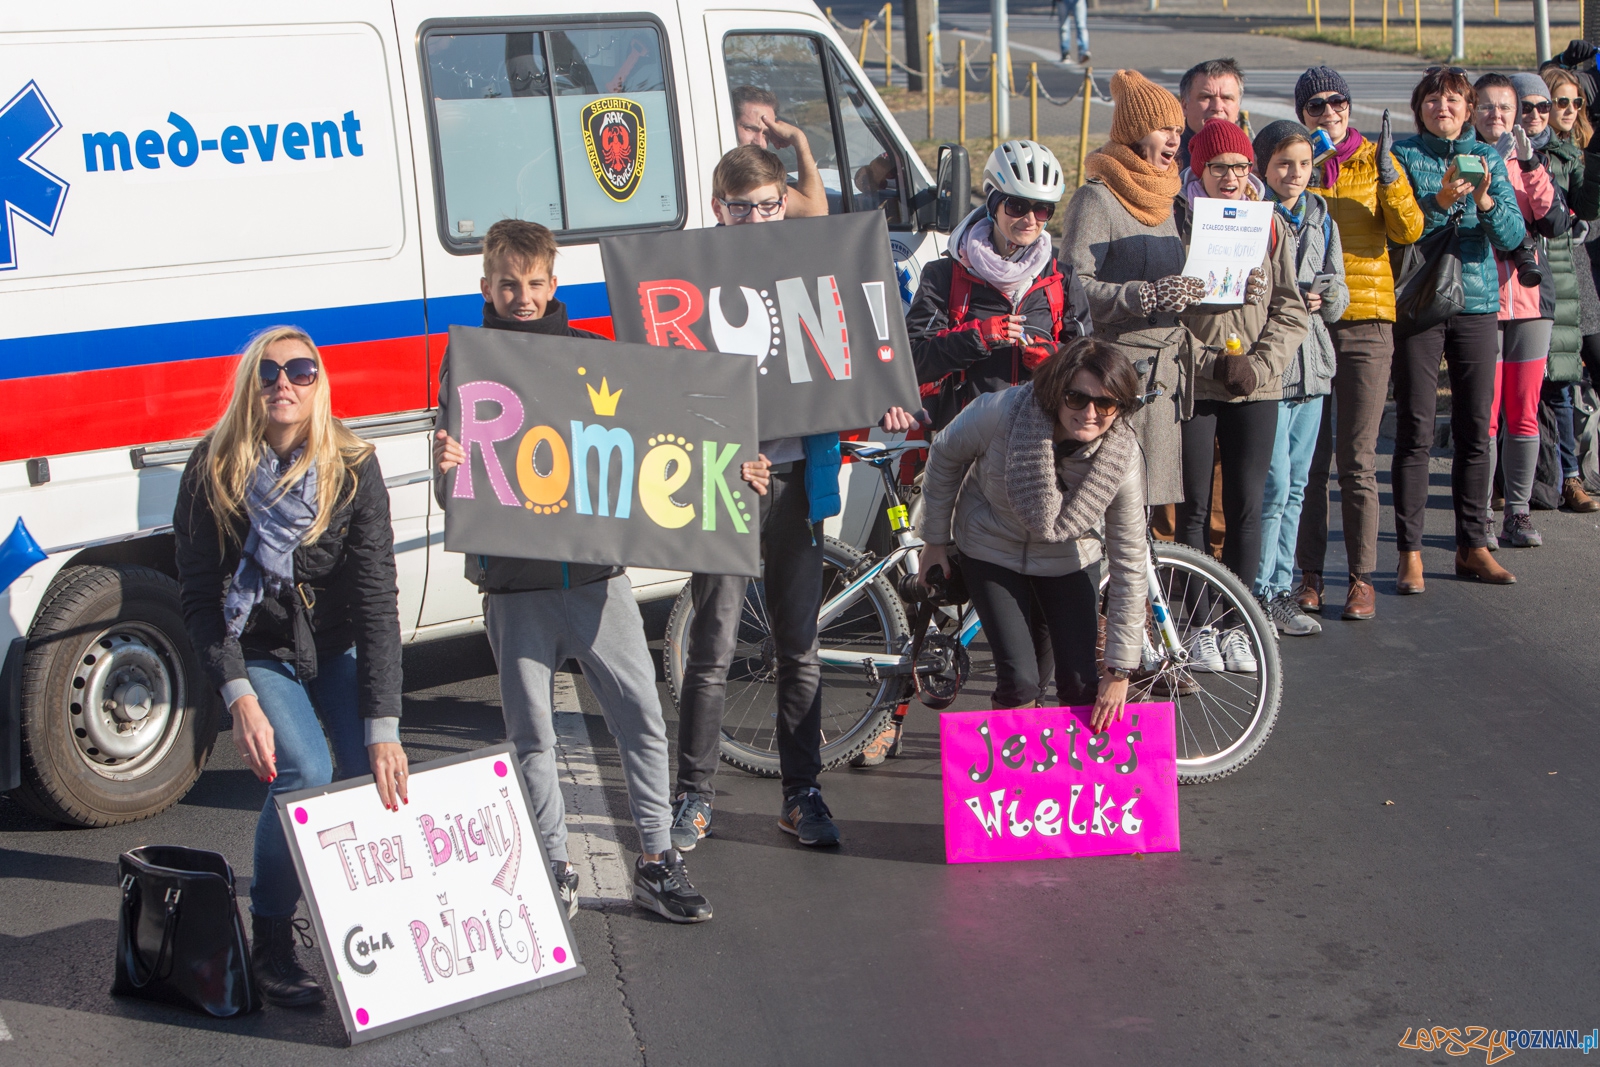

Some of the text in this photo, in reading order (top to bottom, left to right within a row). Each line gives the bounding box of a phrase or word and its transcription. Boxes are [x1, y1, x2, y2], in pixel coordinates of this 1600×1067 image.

[591, 99, 632, 114] SECURITY
[82, 110, 364, 172] med-event
[584, 130, 603, 180] AGENCJA
[636, 127, 646, 177] OCHRONY
[605, 162, 634, 187] SERVICE
[967, 714, 1143, 784] Jesteś
[965, 783, 1143, 840] Wielki
